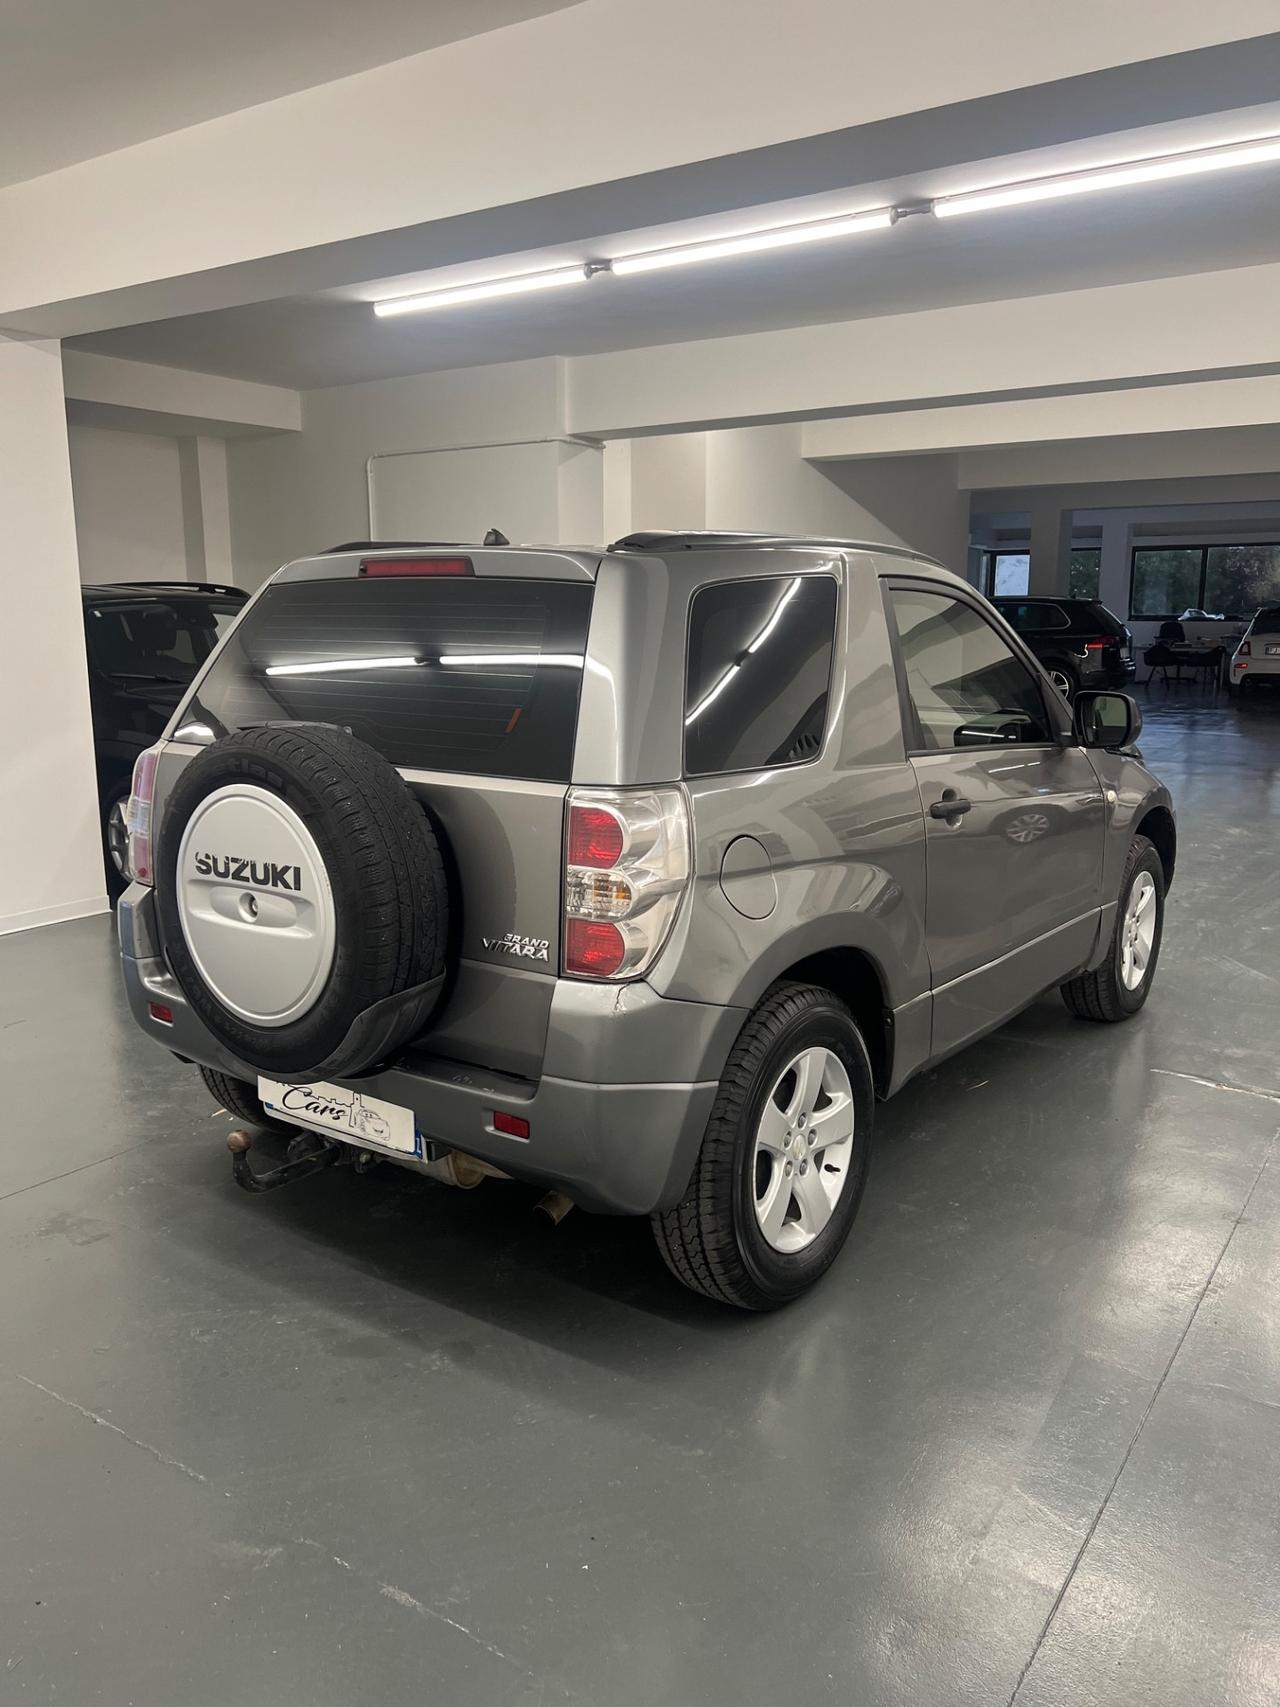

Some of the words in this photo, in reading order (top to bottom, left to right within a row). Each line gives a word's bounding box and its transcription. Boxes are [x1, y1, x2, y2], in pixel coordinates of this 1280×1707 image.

[195, 851, 301, 891] SUZUKI
[482, 937, 549, 962] VITARA
[504, 933, 549, 948] GRAND
[282, 1086, 346, 1120] Cars
